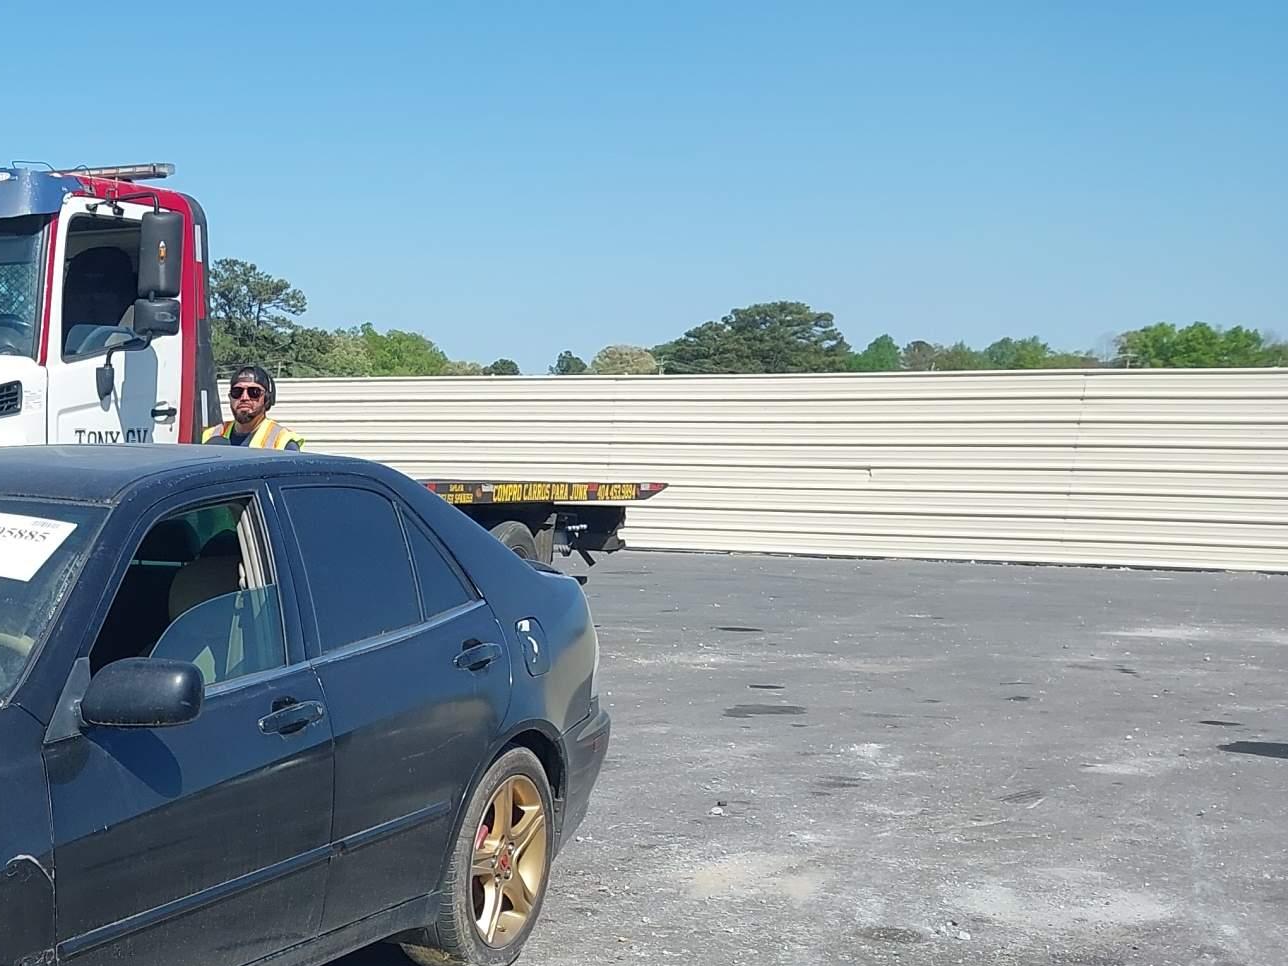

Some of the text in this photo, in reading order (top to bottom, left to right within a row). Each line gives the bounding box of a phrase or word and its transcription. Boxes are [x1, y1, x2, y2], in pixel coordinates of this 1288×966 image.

[492, 484, 523, 503] COMPRO
[523, 484, 551, 501] CARROS
[551, 484, 569, 501] PARA
[569, 484, 589, 501] JUNK
